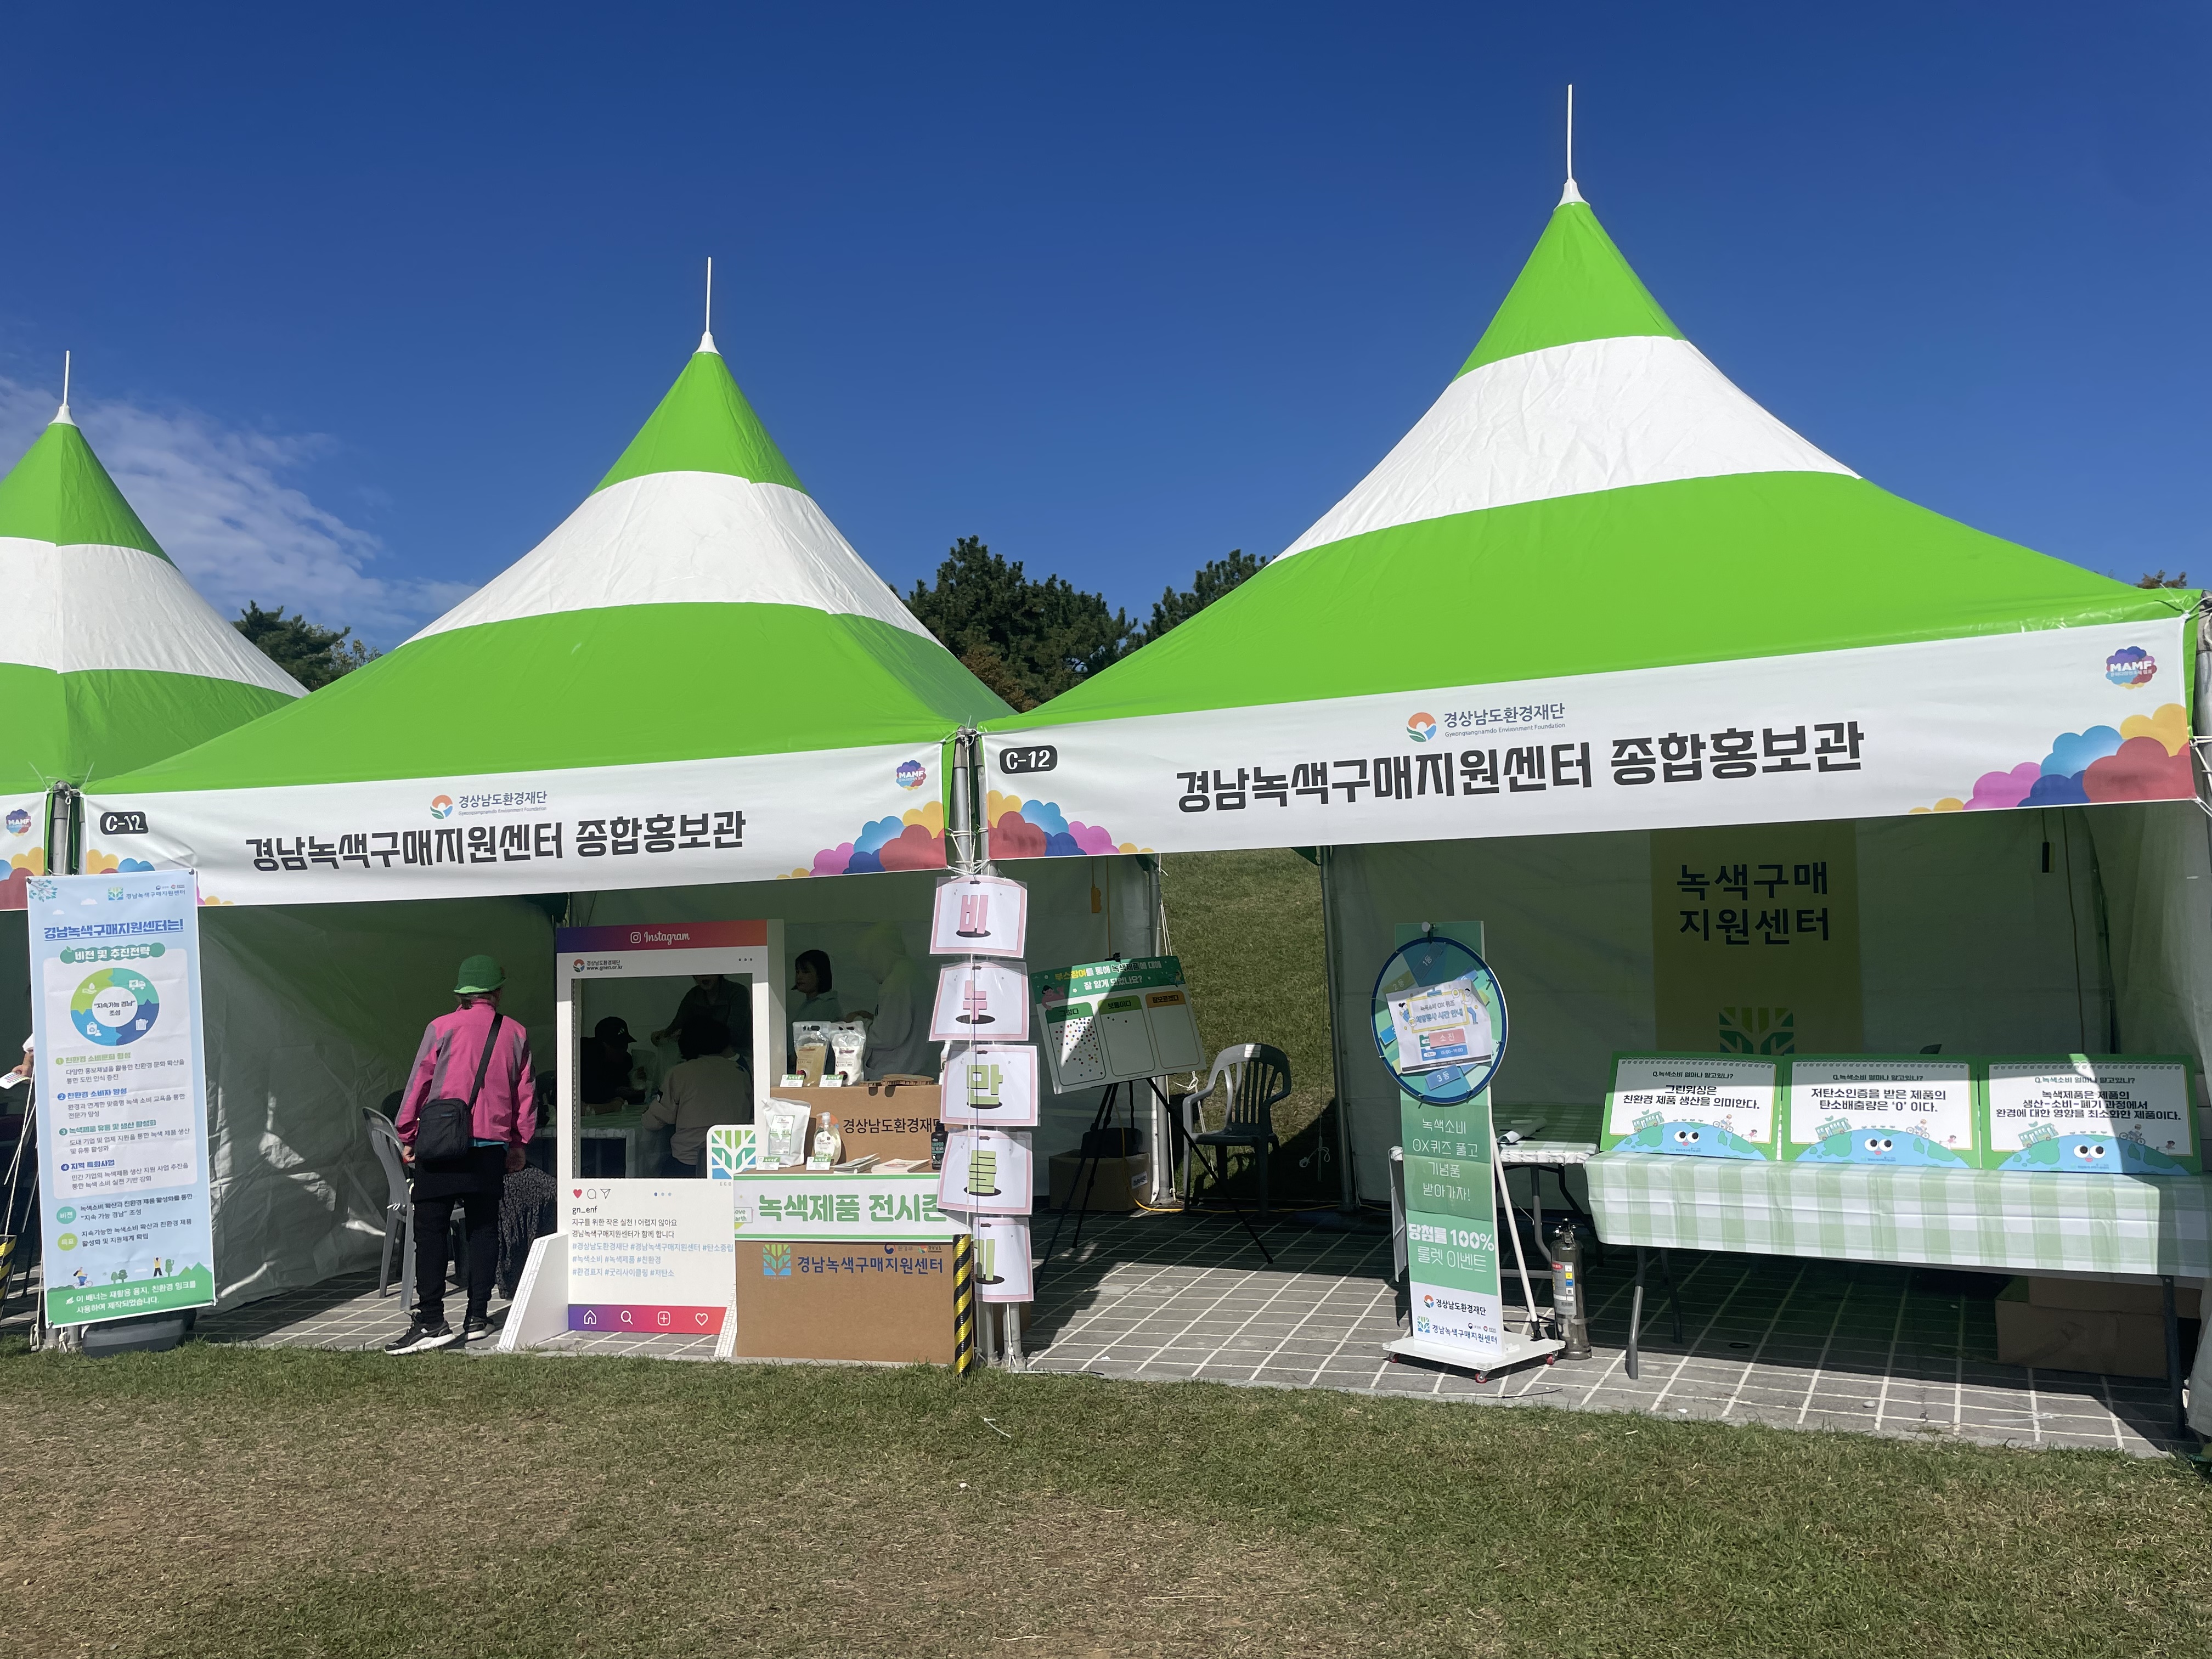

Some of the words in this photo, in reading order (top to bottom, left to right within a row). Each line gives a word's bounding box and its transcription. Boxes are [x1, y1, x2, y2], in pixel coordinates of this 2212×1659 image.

[2110, 661, 2152, 672] MAMF
[1444, 703, 1565, 728] 경상남도환경재단
[1445, 728, 1497, 737] Gyeongsangnamdo
[1006, 750, 1051, 770] C-12
[1177, 742, 1593, 812] 경남녹색구매지원센터
[1610, 720, 1865, 786] 종합홍보관
[459, 791, 548, 808] 경상남도환경재단
[105, 815, 144, 832] C-12
[246, 822, 562, 871] 경남녹색구매지원센터
[575, 809, 746, 858] 종합홍보관
[1677, 862, 1827, 900] 녹색구매
[126, 890, 185, 899] 경남녹색구매지원센터
[960, 895, 988, 934] 비
[44, 919, 183, 939] 경남녹색구매지원센터는!
[1680, 908, 1829, 945] 지원센터
[644, 931, 690, 945] Instagram
[75, 950, 94, 961] 비전
[97, 949, 107, 959] 및
[110, 946, 150, 957] 추진전략
[1055, 968, 1093, 980] 부스참여를
[1096, 966, 1110, 975] 통해
[1093, 979, 1109, 989] 알게
[1110, 975, 1142, 986] 되었나요?
[1108, 1000, 1131, 1009] 보통이다
[1440, 1032, 1455, 1042] 소진
[967, 1064, 1003, 1105] 만
[1665, 1085, 1717, 1095] 그린워싱은
[1623, 1095, 1653, 1104] 친환경
[1656, 1096, 1676, 1105] 제품
[1680, 1096, 1710, 1106] 생산을
[1713, 1098, 1759, 1109] 의미한다.
[1812, 1088, 1880, 1099] 저탄소인증을
[1884, 1089, 1906, 1099] 받은
[1910, 1090, 1946, 1100] 제품의
[2042, 1091, 2094, 1099] 녹색제품은
[2098, 1091, 2129, 1100] 제품의
[1820, 1100, 1888, 1110] 탄소배출량은
[1911, 1102, 1938, 1112] 이다.
[2023, 1100, 2101, 1109] 생산-소비-폐기
[2105, 1101, 2147, 1109] 과정에서
[1996, 1109, 2027, 1118] 환경에
[2029, 1109, 2050, 1118] 대한
[2053, 1109, 2084, 1118] 영향을
[2088, 1109, 2131, 1119] 최소화한
[2134, 1110, 2181, 1120] 제품이다.
[1423, 1119, 1466, 1134] 녹색소비
[1413, 1139, 1451, 1155] OX퀴즈
[1456, 1143, 1478, 1157] 풀고
[1428, 1162, 1460, 1178] 기념품
[1423, 1183, 1470, 1201] 받아가자!
[572, 1206, 597, 1215] gn_enf
[759, 1194, 859, 1222] 녹색제품
[572, 1230, 640, 1238] 경남녹색구매지원센터가
[1408, 1223, 1447, 1244] 당첨률
[1450, 1229, 1494, 1251] 100%
[572, 1243, 628, 1251] #경상남도환경재단
[630, 1243, 700, 1251] #경남녹색구매지원센터
[702, 1244, 733, 1252] #탄소중립
[605, 1256, 635, 1264] #녹색제품
[637, 1256, 661, 1265] #친환경
[798, 1256, 943, 1274] 경남녹색구매지원센터
[1418, 1246, 1443, 1265] 룰렛
[1447, 1251, 1487, 1272] 이벤트
[86, 1293, 108, 1301] 배너는
[110, 1289, 131, 1298] 재활용
[152, 1284, 173, 1293] 친환경
[175, 1280, 196, 1289] 잉크를
[76, 1305, 105, 1313] 사용하여
[108, 1296, 159, 1309] 제작되었습니다.
[1436, 1299, 1486, 1316] 경상남도환경재단
[1432, 1324, 1497, 1345] 경남녹색구매지원센터
